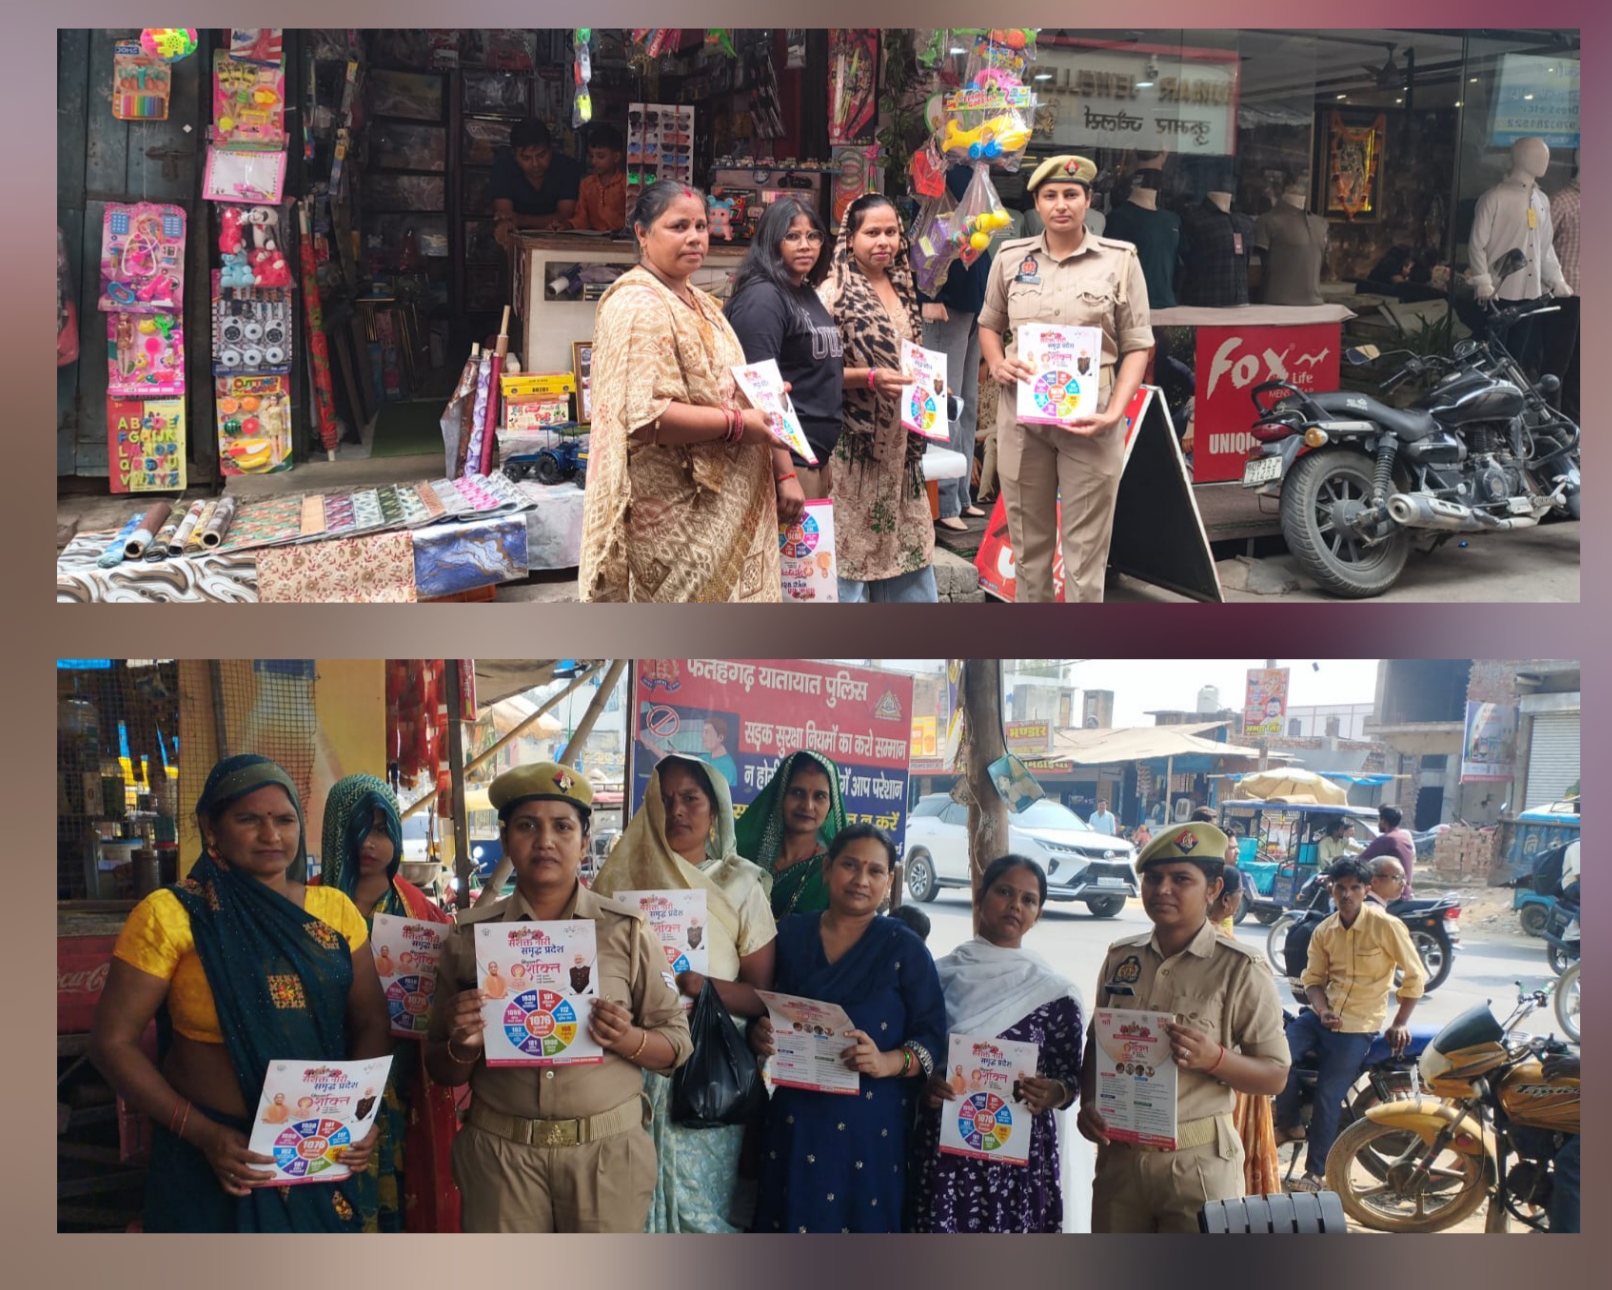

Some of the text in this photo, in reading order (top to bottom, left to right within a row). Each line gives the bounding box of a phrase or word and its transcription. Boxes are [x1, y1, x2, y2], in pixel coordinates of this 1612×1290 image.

[1292, 372, 1313, 384] Life
[1209, 431, 1263, 455] UNIQU
[758, 667, 821, 695] यातायात
[825, 670, 868, 708] पुलिस
[745, 720, 907, 760] सड़क सुरक्षा नियमों का करो सम्मान
[744, 765, 754, 790] न
[851, 775, 870, 797] आप
[872, 771, 904, 801] परेशान
[875, 810, 899, 832] करें
[534, 936, 551, 947] नारी
[529, 1016, 551, 1025] 1076
[303, 1140, 325, 1149] 1076
